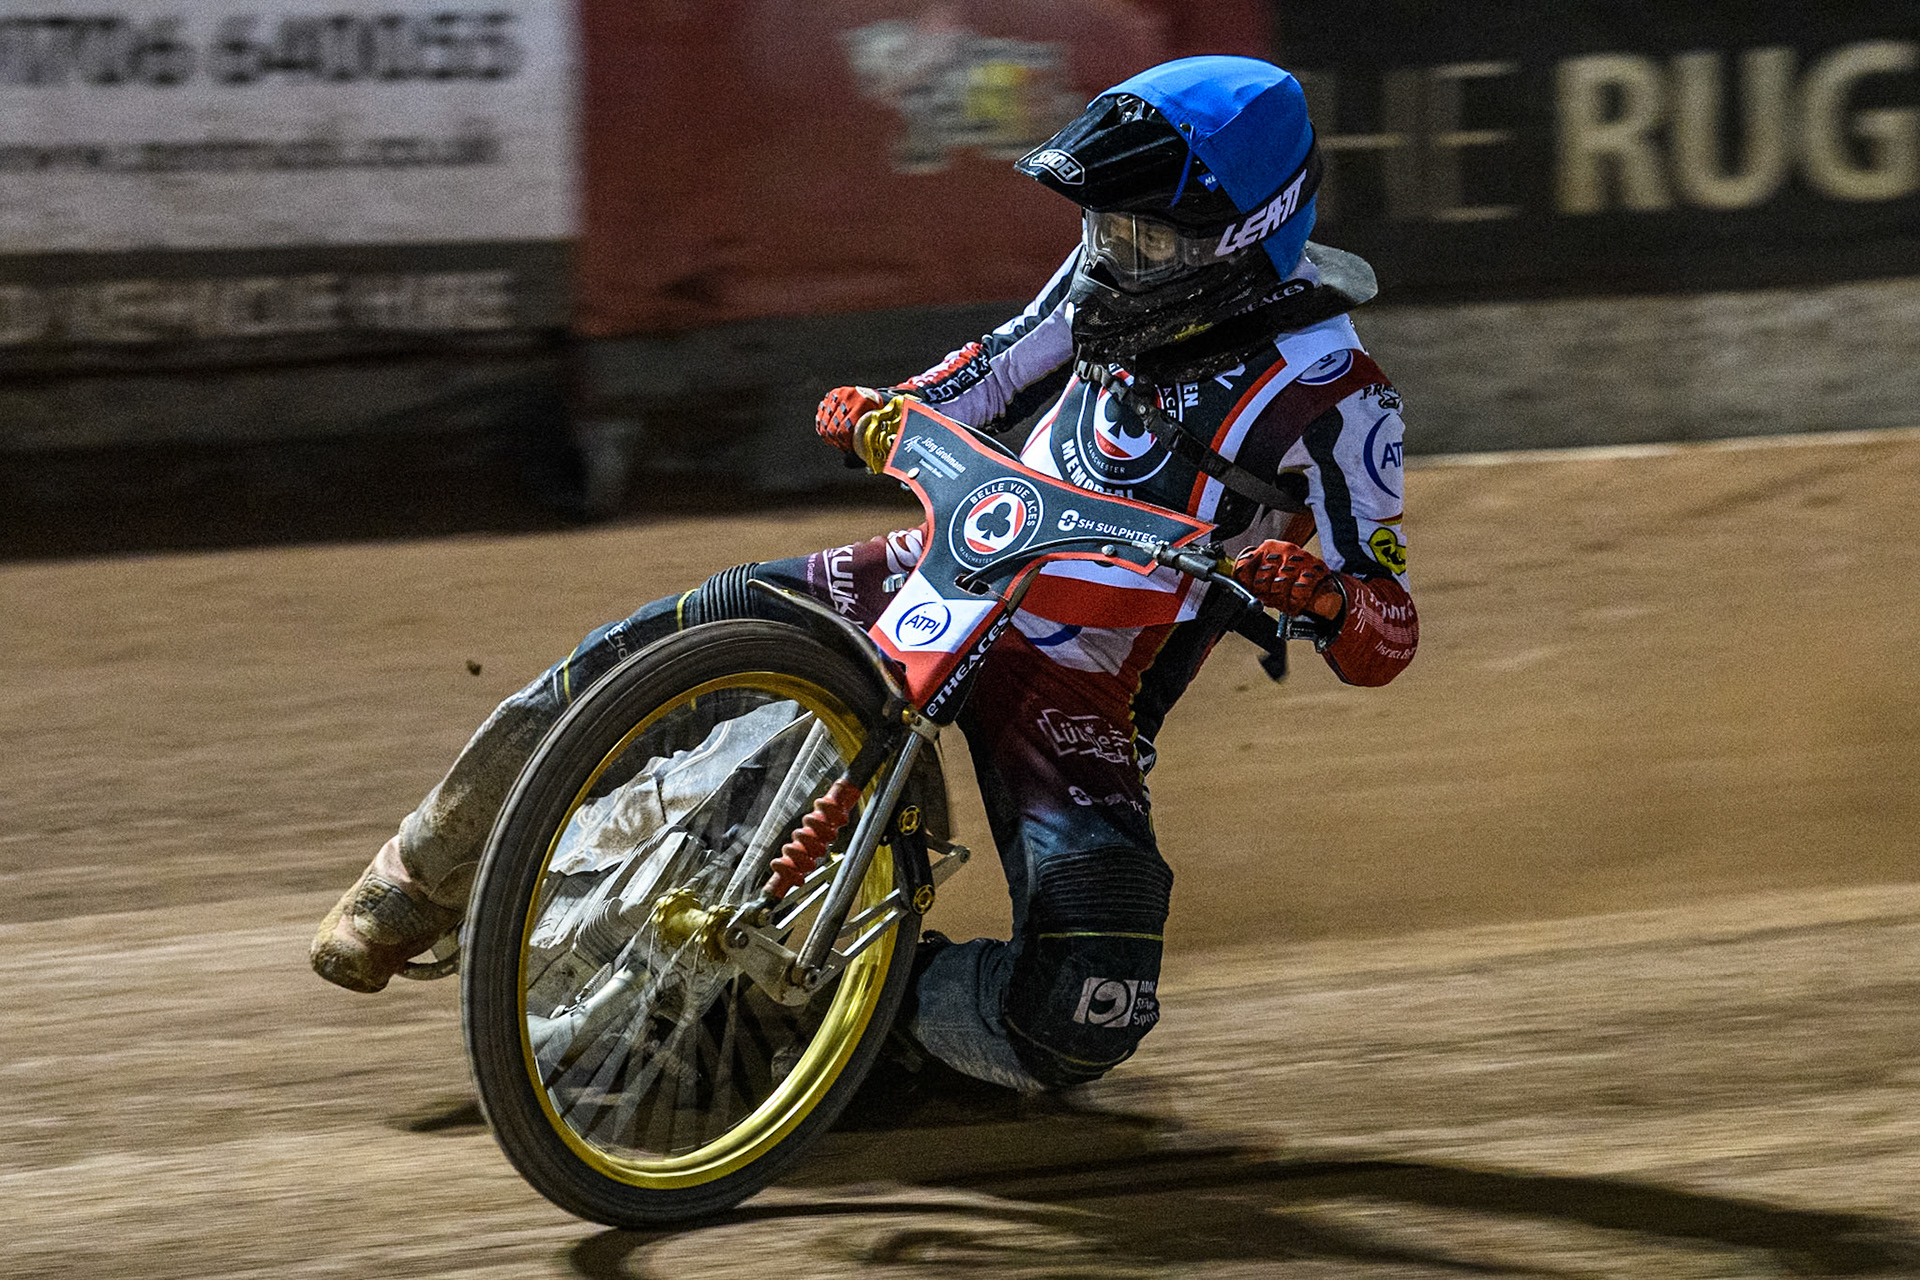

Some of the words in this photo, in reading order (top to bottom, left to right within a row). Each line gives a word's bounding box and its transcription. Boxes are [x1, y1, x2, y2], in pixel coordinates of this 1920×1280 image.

[1032, 152, 1082, 182] SHOEI
[1215, 168, 1308, 257] LEATT
[1087, 440, 1126, 474] MANCHESTER
[969, 482, 1005, 505] BELLE
[1010, 482, 1031, 499] VUE
[1025, 499, 1038, 527] ACES
[904, 614, 941, 635] ATPI
